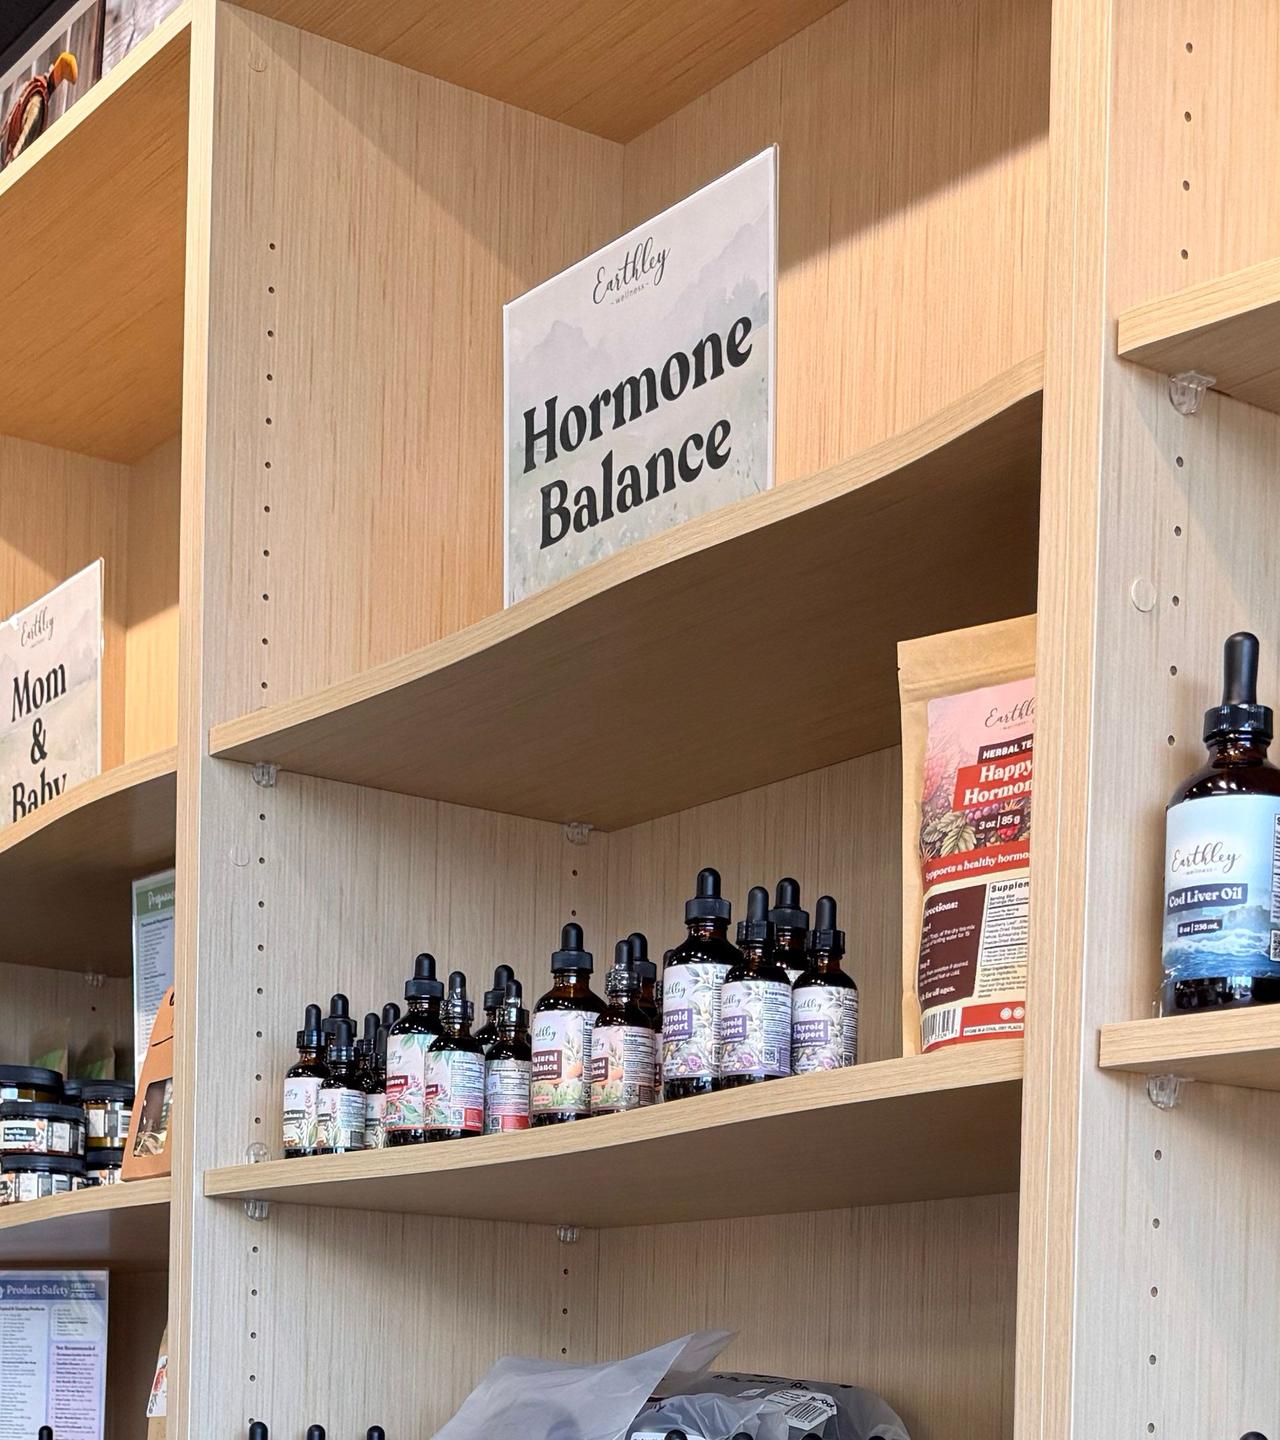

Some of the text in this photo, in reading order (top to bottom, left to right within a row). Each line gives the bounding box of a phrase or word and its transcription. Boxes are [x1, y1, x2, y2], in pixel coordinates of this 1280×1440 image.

[593, 236, 671, 305] Earthley
[522, 315, 753, 475] Hormone
[539, 418, 733, 550] Balance
[11, 663, 67, 723] Mom
[30, 717, 48, 765] &
[982, 746, 1020, 760] HERBAL
[985, 820, 996, 829] oz
[1001, 815, 1013, 826] 85
[964, 855, 997, 871] healthy
[1172, 842, 1241, 873] Earthley
[1169, 886, 1242, 908] Cod Liver Oil
[7, 1284, 40, 1295] Product
[42, 1284, 69, 1296] Safety
